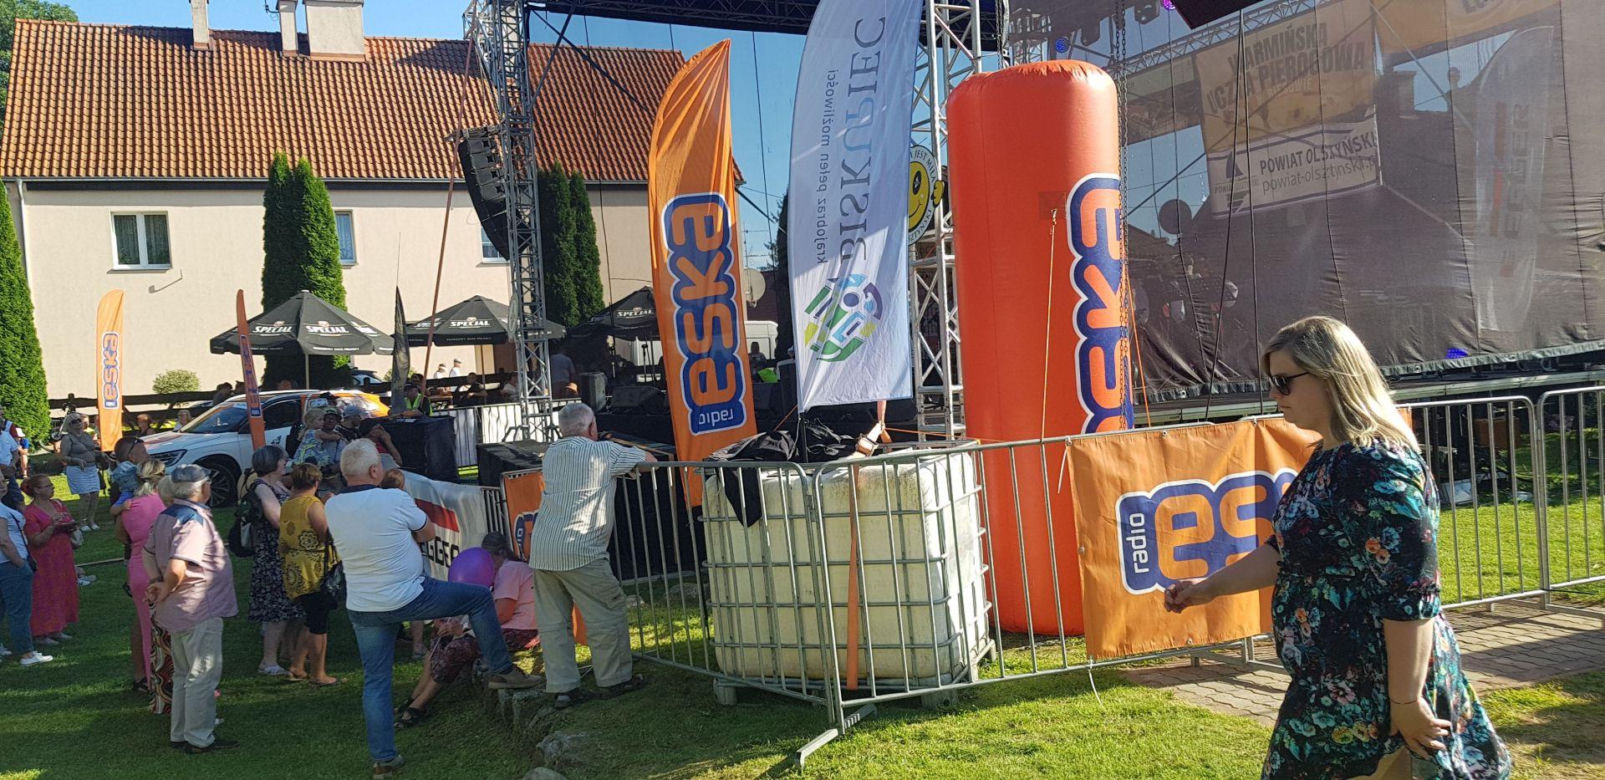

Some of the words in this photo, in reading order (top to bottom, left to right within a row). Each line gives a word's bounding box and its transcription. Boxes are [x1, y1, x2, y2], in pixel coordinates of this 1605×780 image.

[1259, 150, 1304, 175] POWIAT
[671, 202, 737, 406] eska
[103, 333, 119, 400] eska
[698, 408, 734, 427] radio
[1126, 512, 1150, 574] radio
